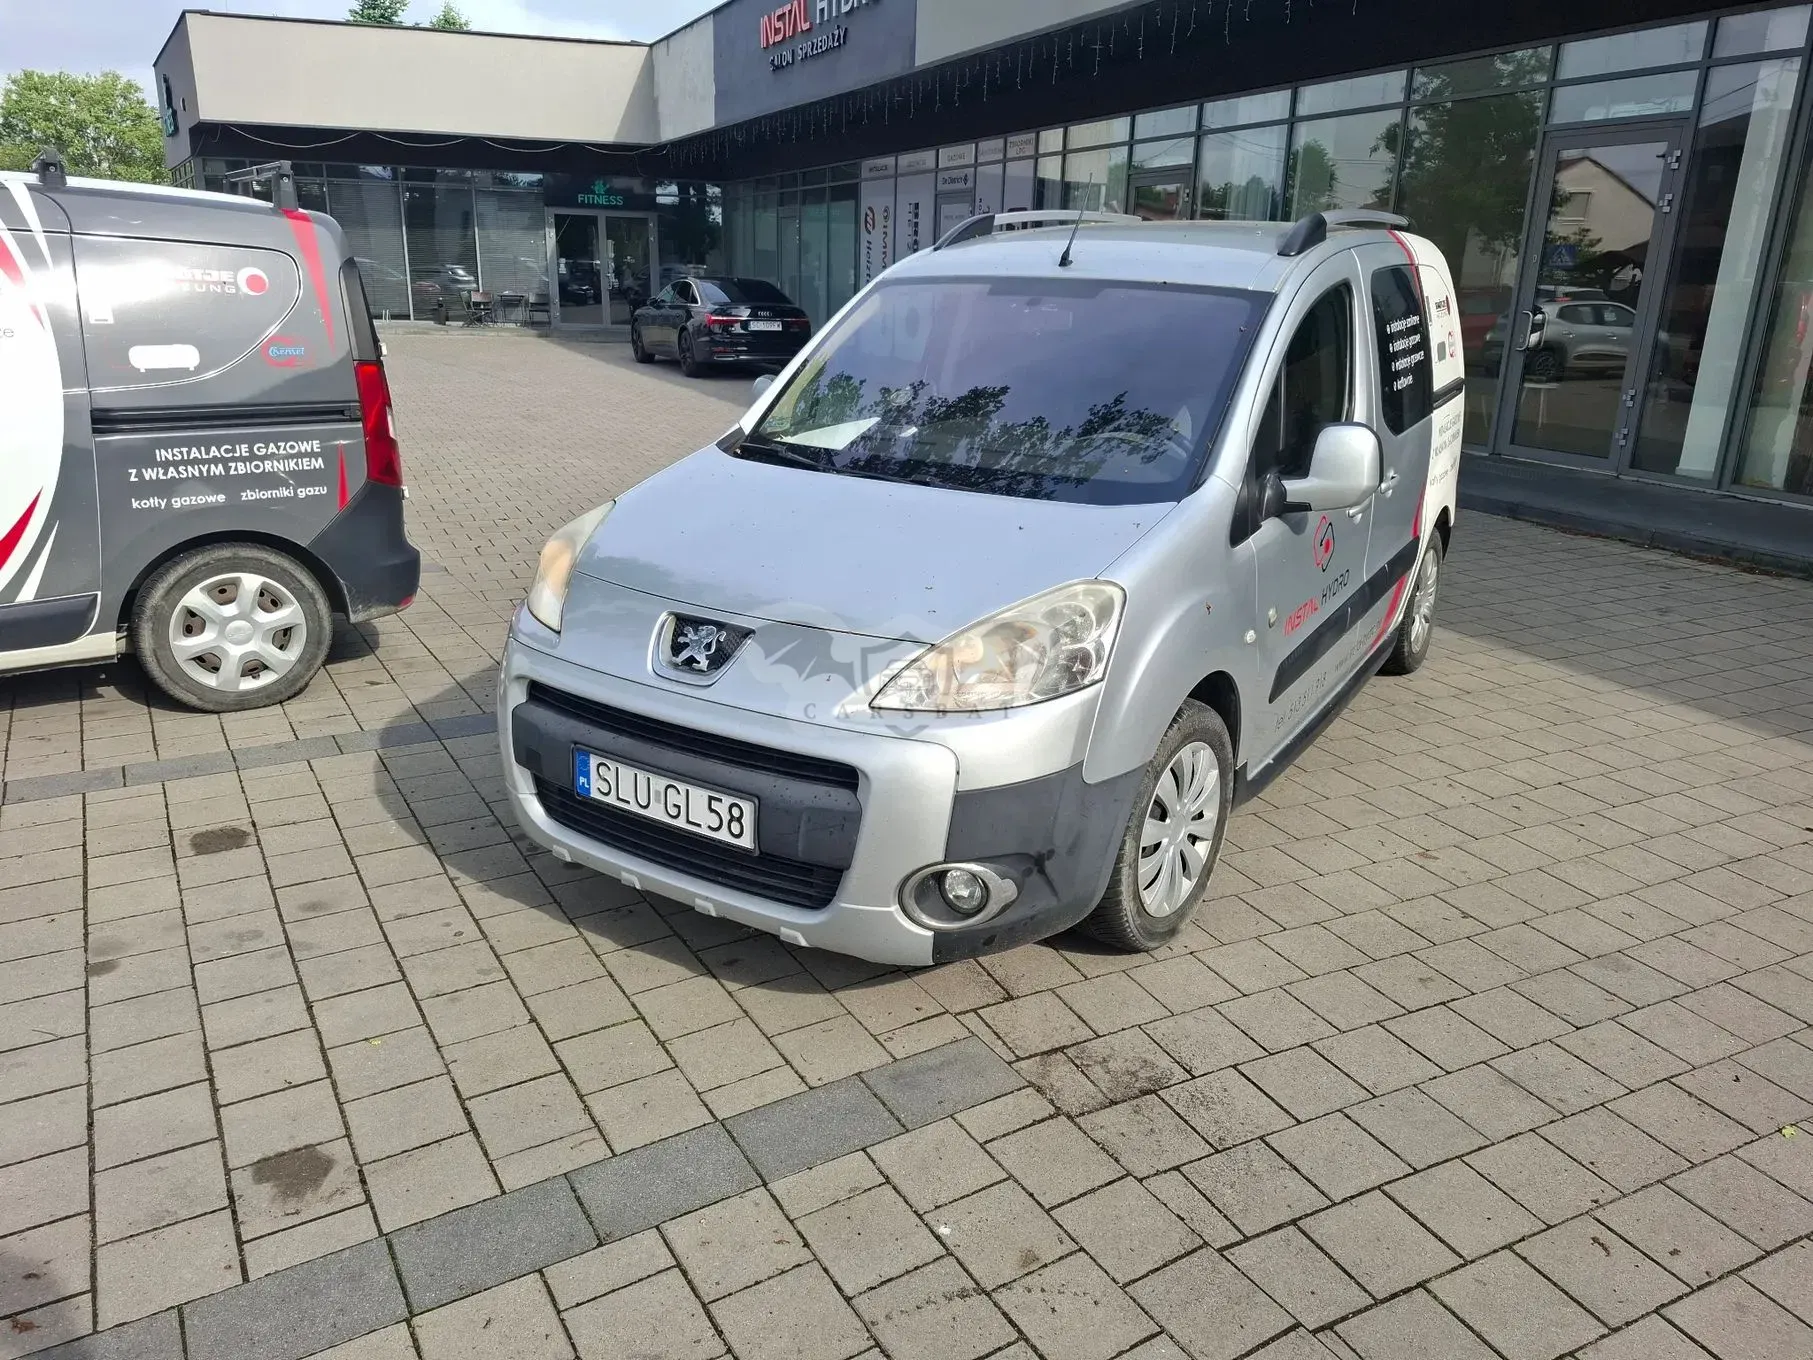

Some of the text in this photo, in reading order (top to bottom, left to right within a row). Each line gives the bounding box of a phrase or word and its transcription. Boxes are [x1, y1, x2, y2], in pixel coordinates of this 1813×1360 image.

[760, 0, 811, 48] INSTAL
[797, 25, 848, 60] SPRZEDAŻY
[577, 193, 625, 206] FITNESS
[155, 440, 321, 461] INSTALACJE GAZOWE
[128, 457, 325, 482] Z WŁASNYM ZBIORNIKIEM
[131, 485, 328, 509] kotły gazowe zbiorniki gazu
[1283, 568, 1350, 638] INSTAL HYDRO
[579, 776, 590, 788] PL
[596, 761, 745, 839] SLU GL58
